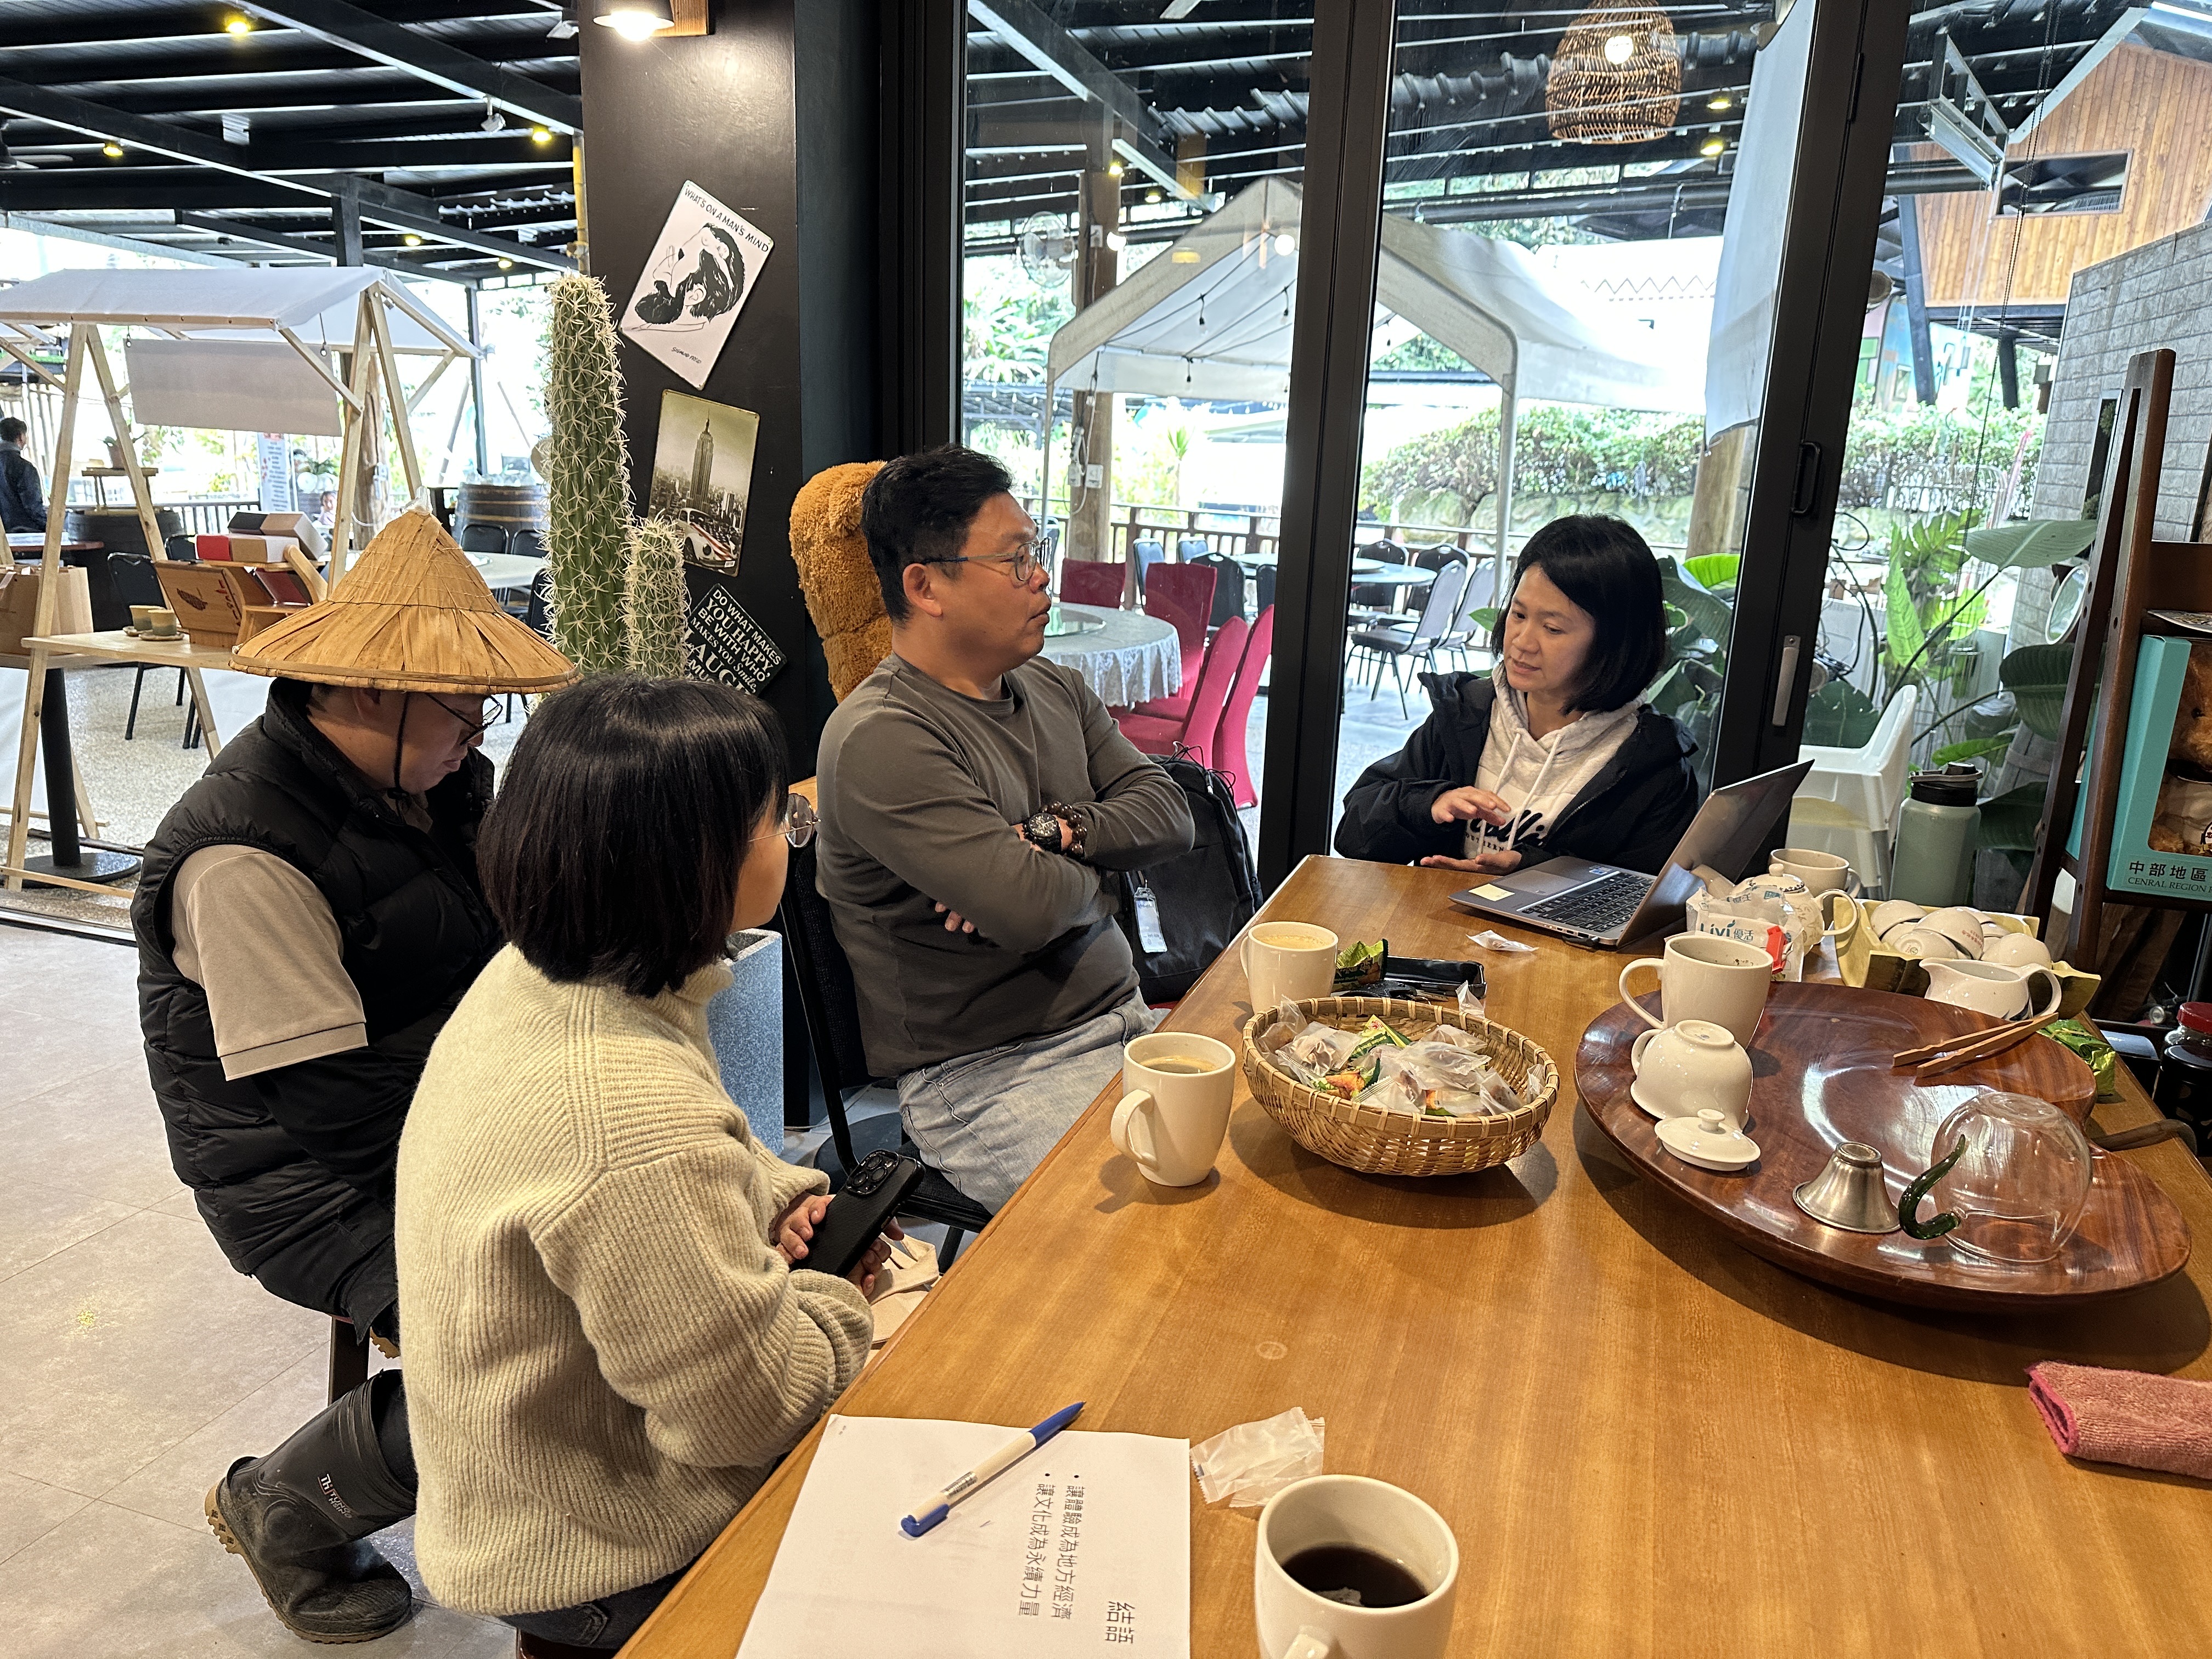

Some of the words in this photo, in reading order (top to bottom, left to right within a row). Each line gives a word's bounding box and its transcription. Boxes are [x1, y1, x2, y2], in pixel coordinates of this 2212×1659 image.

[685, 188, 707, 208] WHAT'S
[706, 204, 717, 216] ON
[715, 212, 723, 221] A
[721, 216, 745, 236] MAN'S
[744, 233, 769, 252] MIND
[690, 617, 719, 648] MAKES
[718, 645, 736, 665] YOU
[698, 607, 715, 627] BE
[714, 623, 741, 655] WITH
[741, 652, 766, 682] WHO
[706, 597, 735, 629] YOU
[731, 627, 774, 678] HAPPY,
[713, 589, 728, 606] DO
[727, 603, 754, 633] WHAT
[751, 630, 781, 665] MAKES
[2128, 877, 2167, 888] CENRAL
[2169, 882, 2207, 893] REGION
[2129, 860, 2209, 882] 中部地區
[1104, 1601, 1136, 1644] 結語
